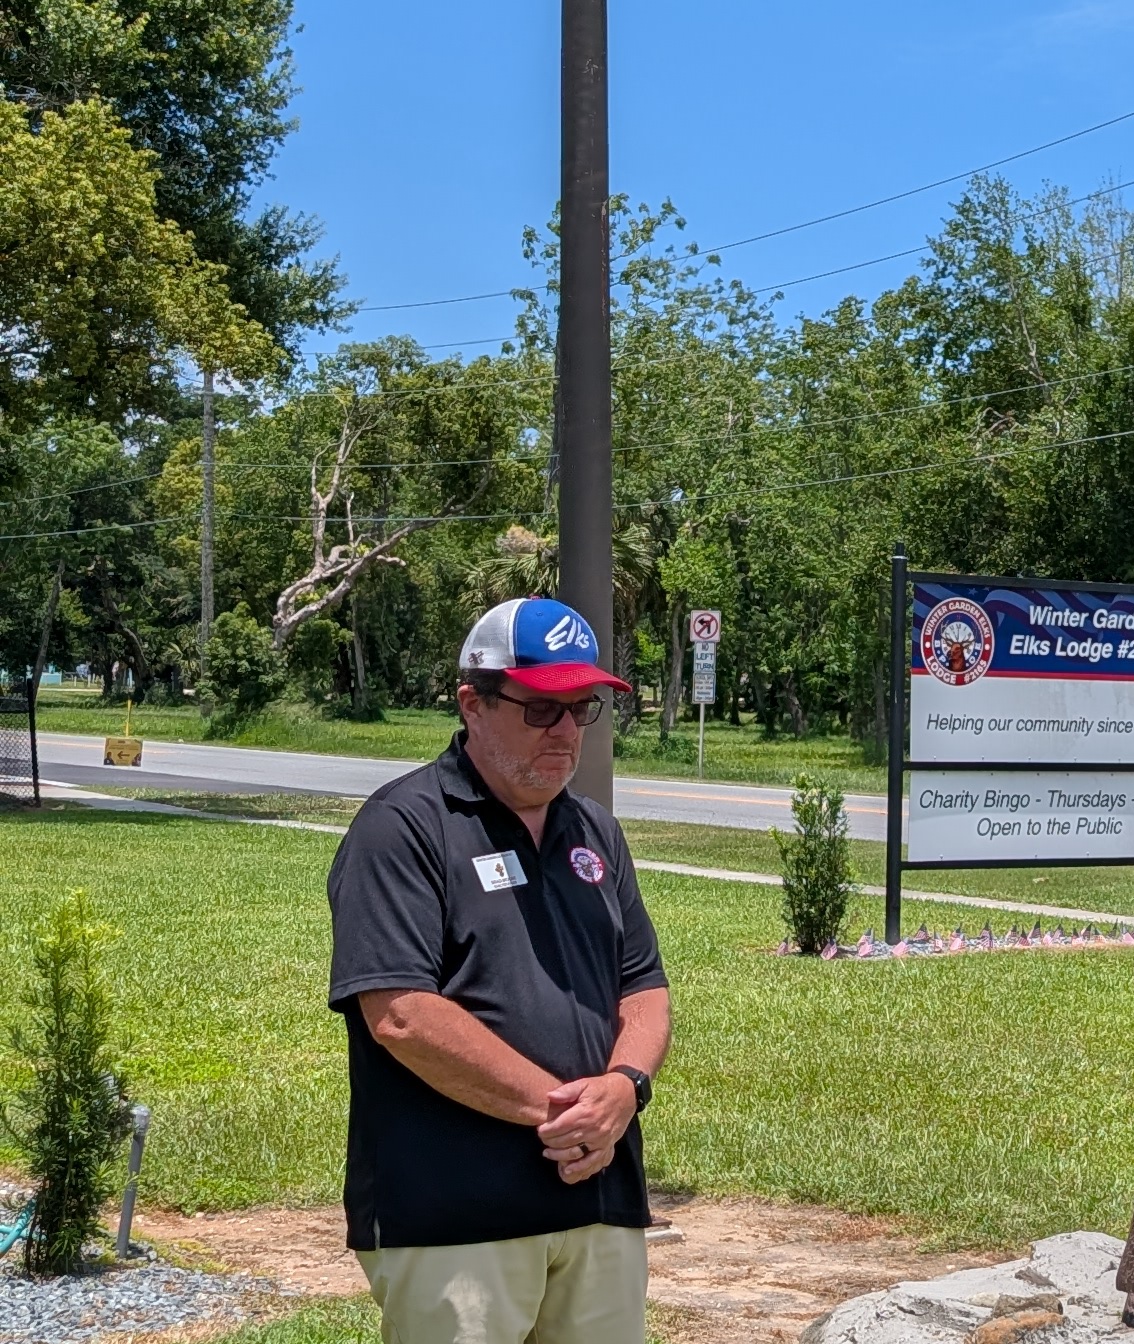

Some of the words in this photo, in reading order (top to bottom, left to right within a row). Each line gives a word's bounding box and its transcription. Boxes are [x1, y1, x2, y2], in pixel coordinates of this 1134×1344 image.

[925, 605, 948, 636] WINTER
[948, 601, 981, 618] GARDEN
[1029, 605, 1090, 627] Winter
[545, 615, 590, 651] Elks
[696, 652, 714, 661] LEFT
[1009, 634, 1051, 656] Elks
[1054, 636, 1114, 663] Lodge
[696, 662, 714, 670] TURN
[926, 655, 957, 684] LODGE
[926, 713, 985, 736] Helping
[987, 718, 1014, 732] our
[1015, 716, 1095, 737] community
[1096, 716, 1134, 734] since
[919, 789, 980, 813] Charity
[983, 789, 1031, 813] Bingo
[1047, 789, 1127, 813] Thursdays
[976, 817, 1022, 841] Open
[1026, 818, 1042, 836] to
[1046, 817, 1071, 836] the
[1075, 816, 1123, 835] Public
